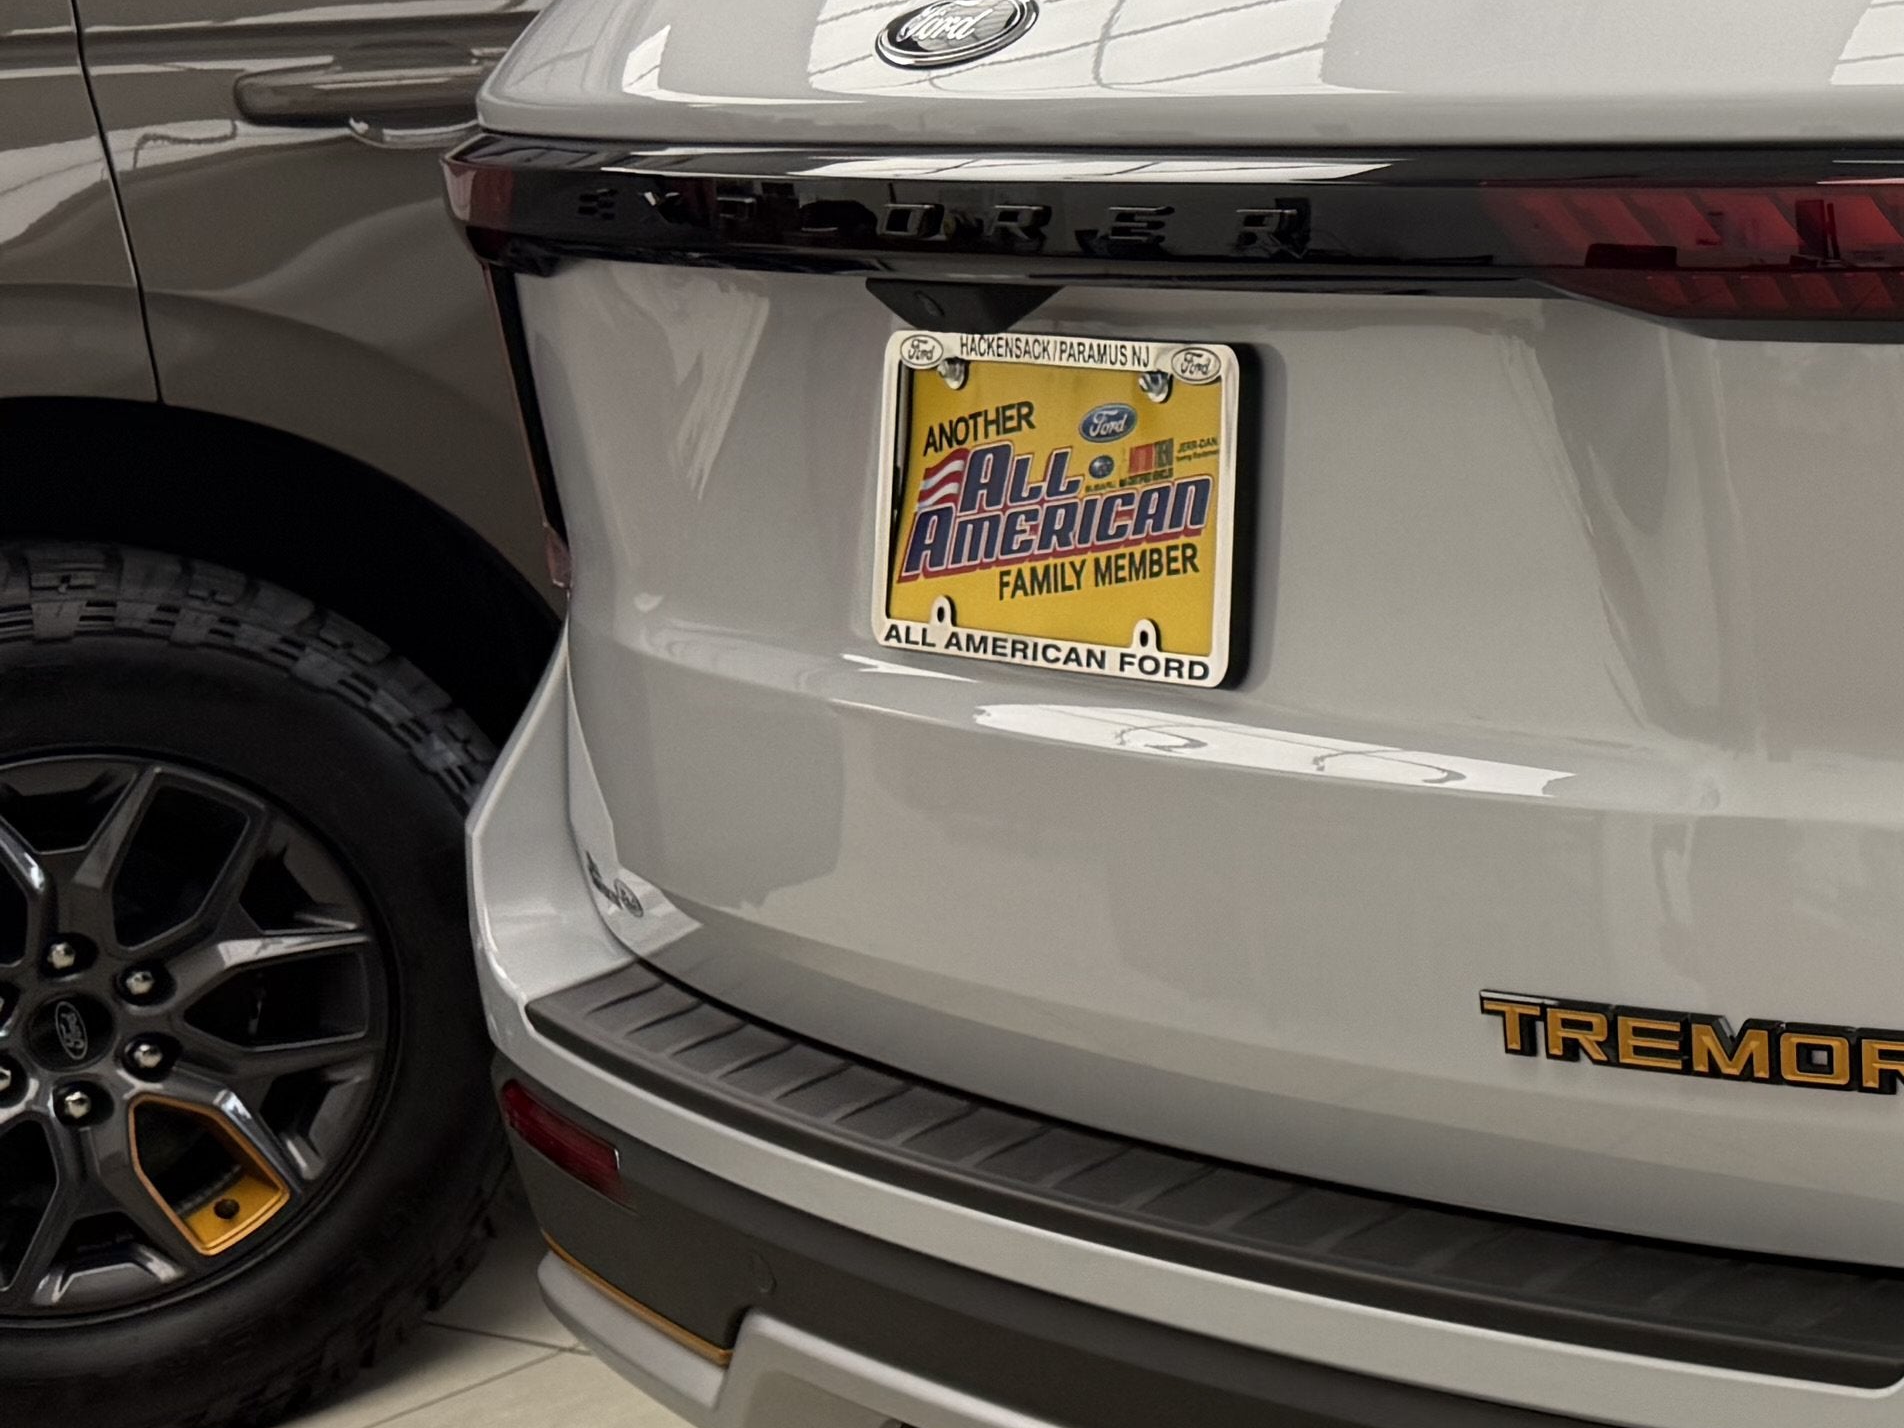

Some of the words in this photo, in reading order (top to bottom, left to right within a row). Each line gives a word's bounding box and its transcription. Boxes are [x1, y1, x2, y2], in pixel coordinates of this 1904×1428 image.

[576, 185, 1312, 257] EXPORER
[1131, 345, 1150, 368] NJ
[923, 400, 1036, 457] ANOTHER
[999, 558, 1087, 601] FAMILY
[1094, 542, 1200, 588] MEMBER
[884, 624, 936, 648] ALL
[944, 631, 1106, 670] AMERICAN
[1119, 652, 1210, 681] FORD
